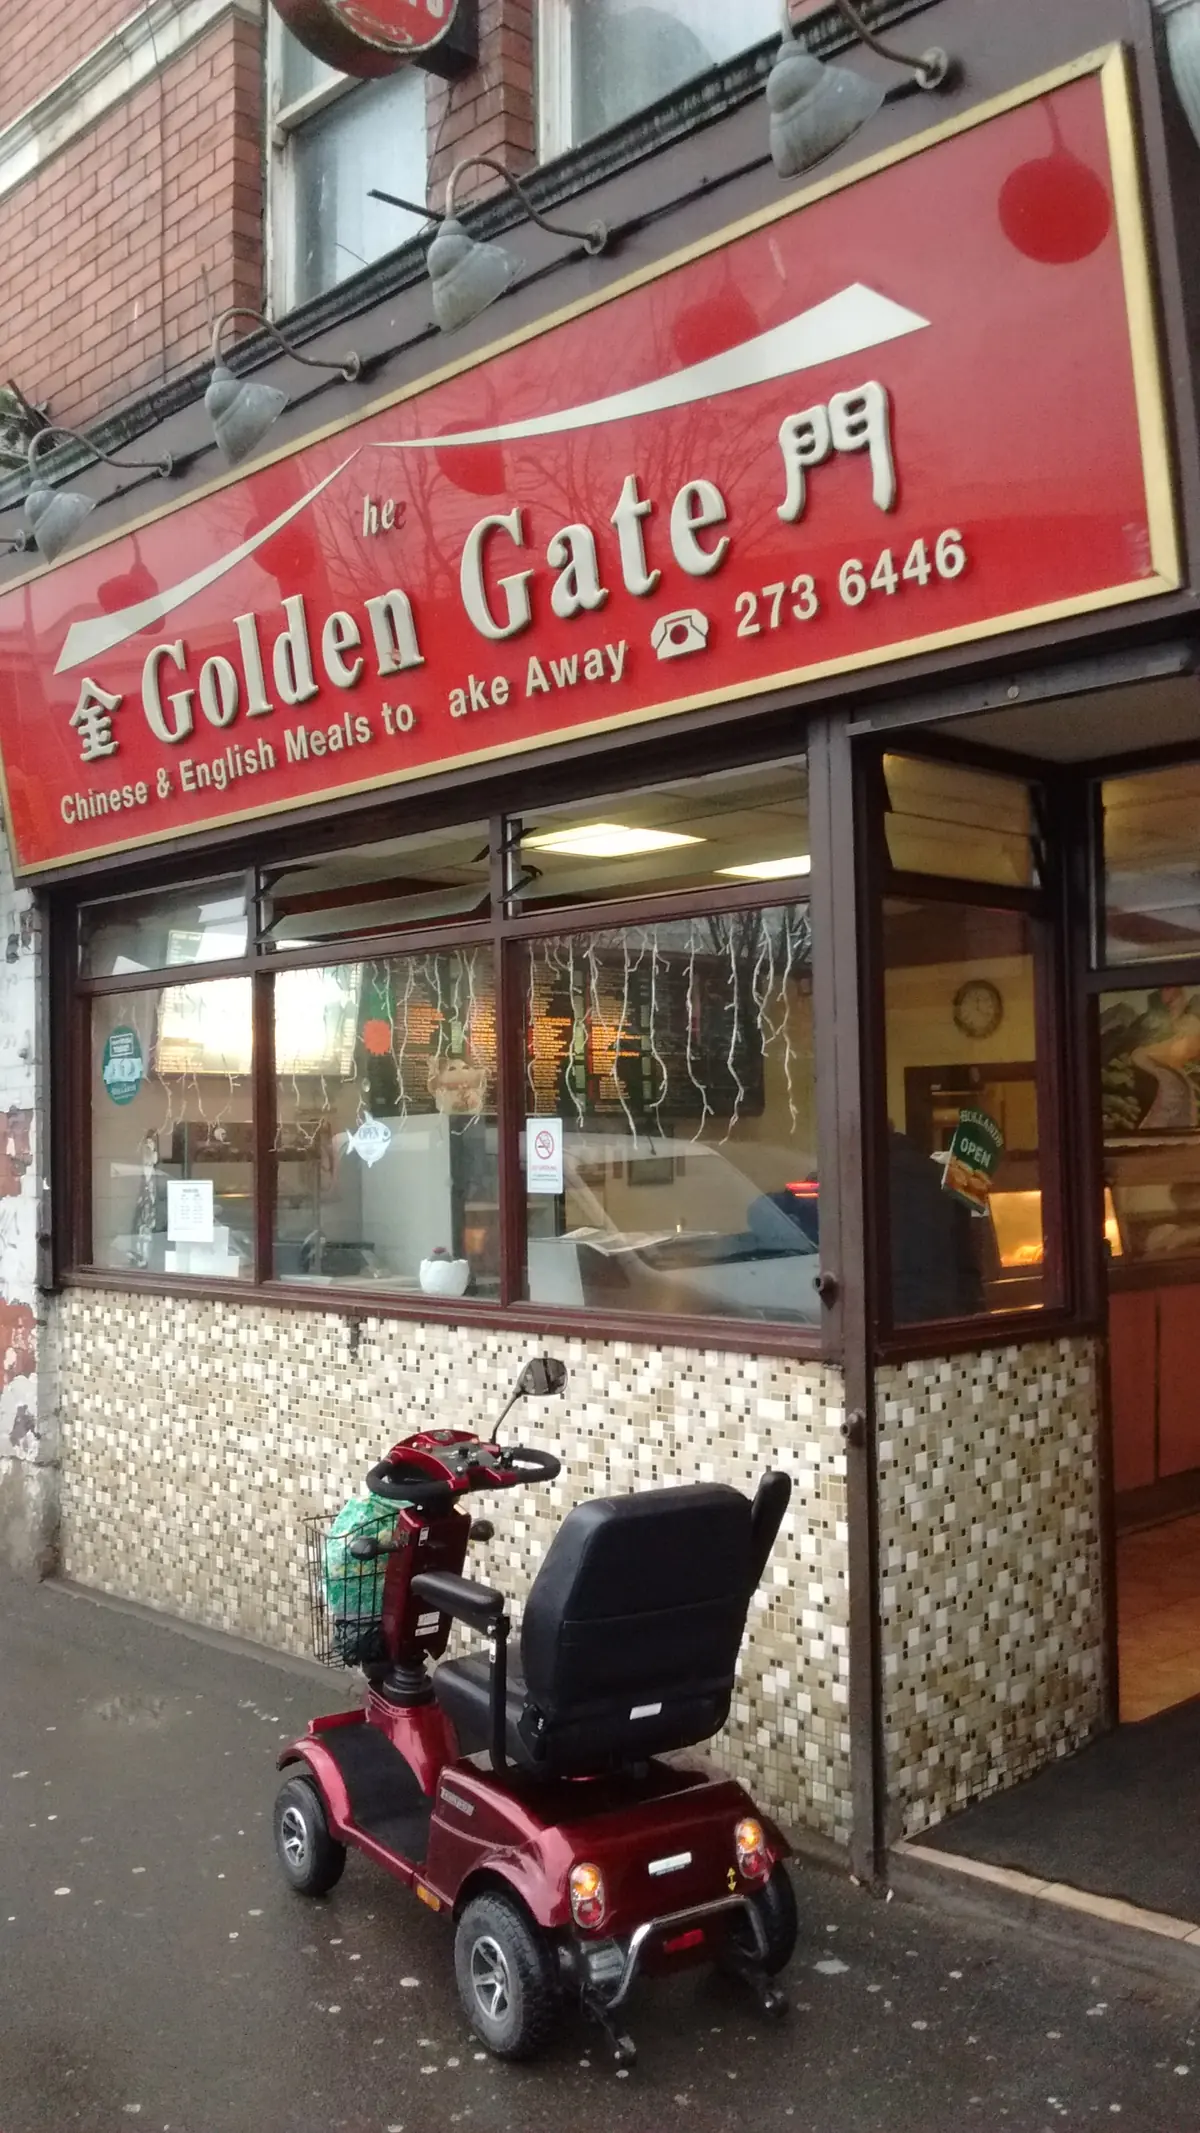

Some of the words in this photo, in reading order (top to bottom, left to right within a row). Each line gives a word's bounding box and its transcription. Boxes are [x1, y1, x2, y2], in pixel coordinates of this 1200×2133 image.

[776, 379, 896, 523] 門
[141, 587, 424, 745] Golden
[459, 473, 731, 640] Gate
[735, 573, 819, 638] 273
[838, 528, 967, 607] 6446
[60, 780, 148, 825] Chinese
[156, 769, 170, 799] &
[180, 738, 275, 794] English
[285, 715, 371, 763] Meals
[381, 700, 415, 736] to
[448, 674, 510, 719] ake
[524, 639, 628, 697] Away
[69, 676, 122, 763] 金
[960, 1137, 992, 1168] OPEN
